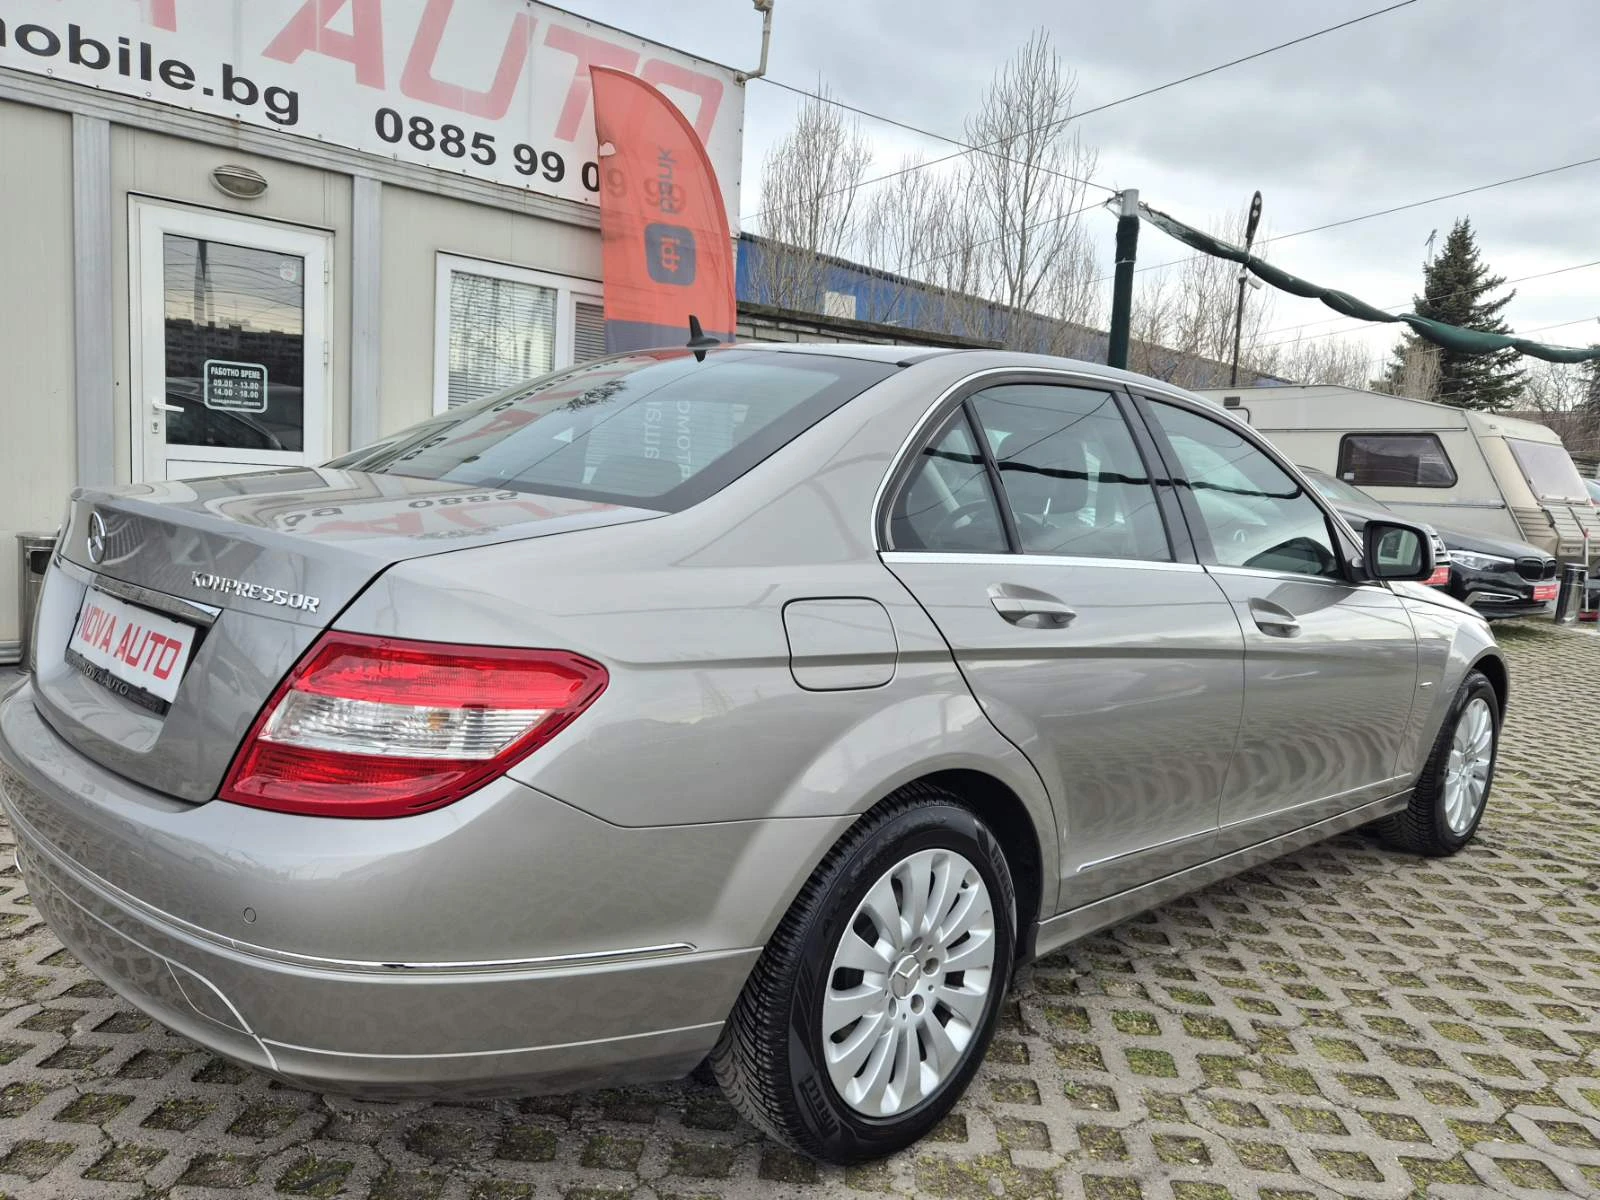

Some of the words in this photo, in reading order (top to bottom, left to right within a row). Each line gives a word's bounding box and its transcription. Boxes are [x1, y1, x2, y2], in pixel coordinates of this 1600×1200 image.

[0, 17, 299, 126] obile.bg
[375, 107, 497, 166] 0885
[512, 143, 565, 183] 99
[211, 367, 240, 377] РАБОТНО
[240, 370, 261, 379] ВРЕМЕ
[191, 570, 320, 614] KOMPRESSOR
[76, 602, 117, 654] NOVA
[113, 622, 183, 681] AUTO
[102, 674, 129, 696] AUTO
